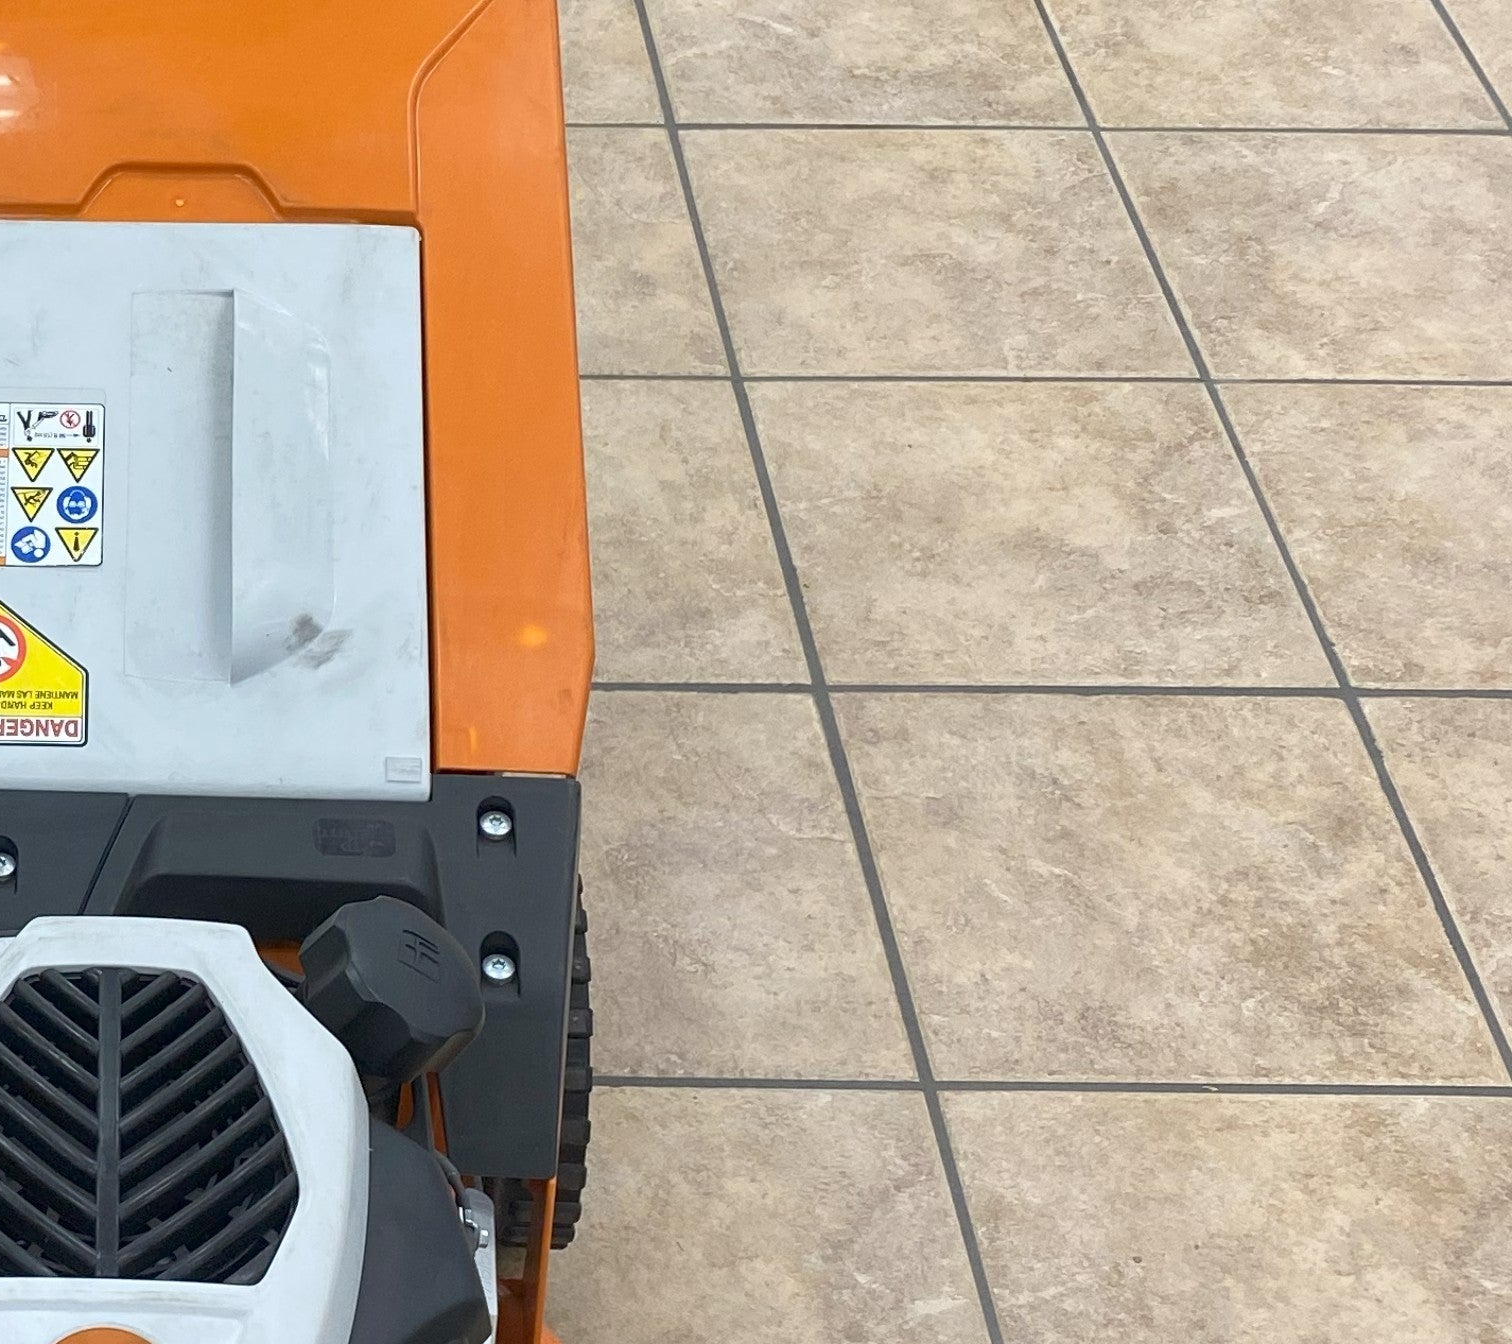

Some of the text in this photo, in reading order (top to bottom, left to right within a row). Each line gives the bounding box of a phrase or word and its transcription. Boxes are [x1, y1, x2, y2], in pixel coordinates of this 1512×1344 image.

[16, 691, 33, 699] LAS
[34, 691, 79, 700] MANTIENE
[29, 701, 53, 710] KEEP
